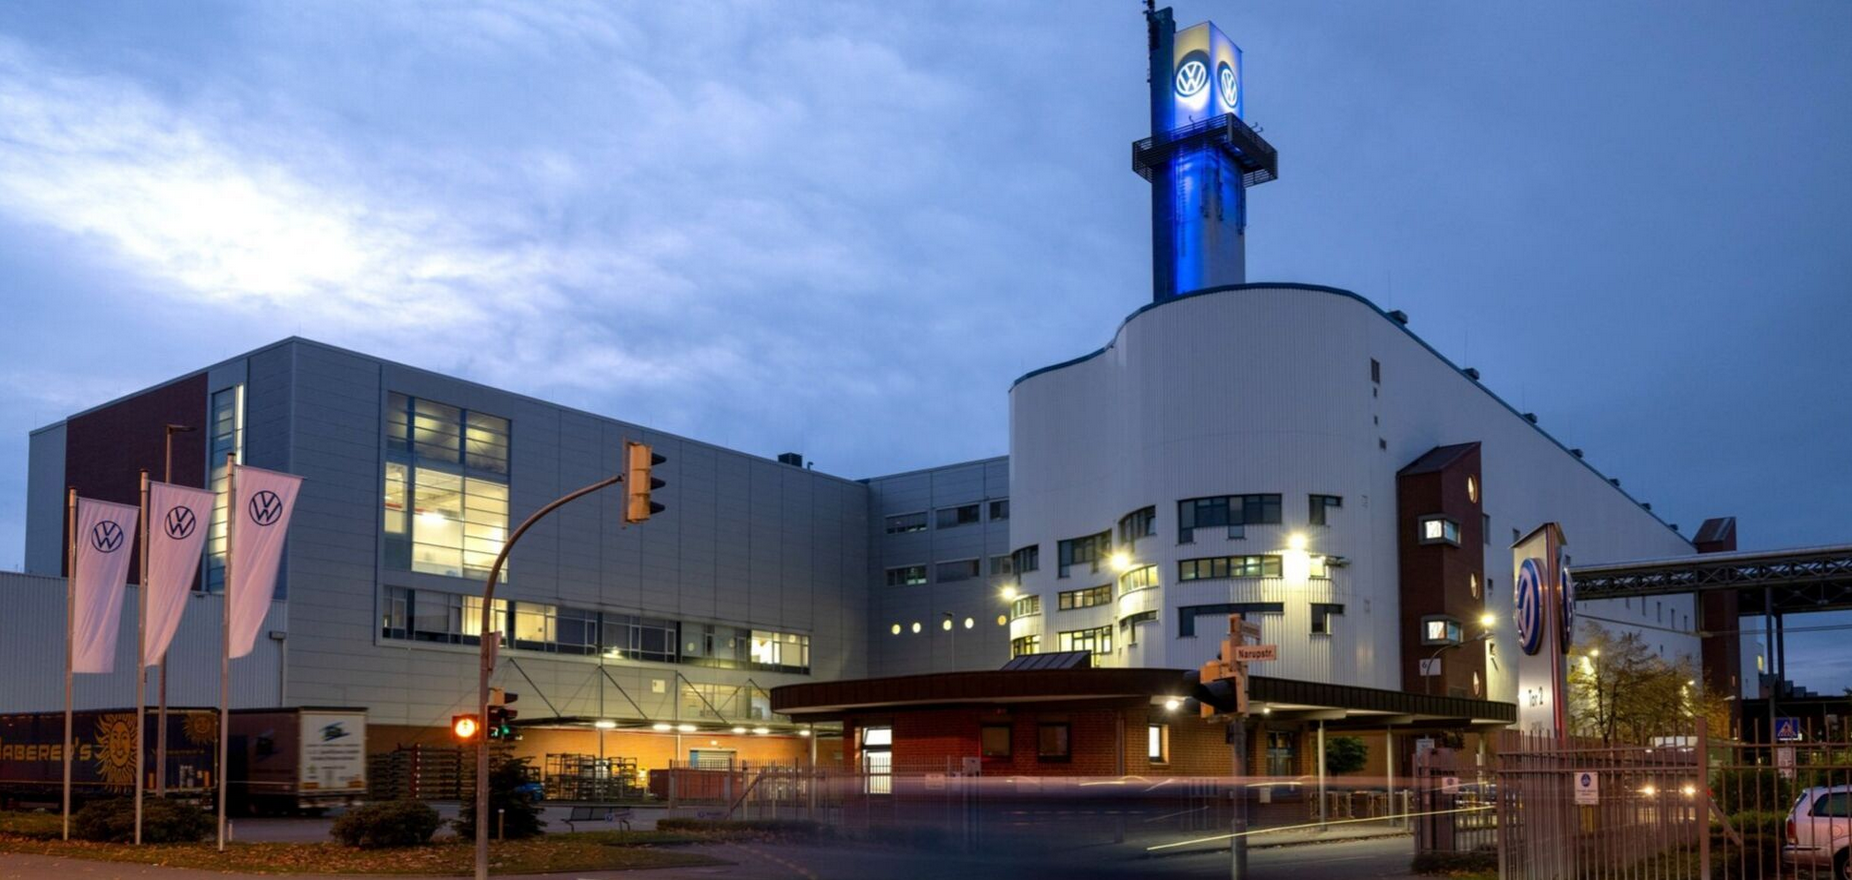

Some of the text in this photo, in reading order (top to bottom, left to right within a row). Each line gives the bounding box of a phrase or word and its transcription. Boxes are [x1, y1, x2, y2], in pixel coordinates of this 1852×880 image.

[1176, 61, 1207, 96] VW
[164, 505, 196, 540] VW
[249, 490, 283, 526] VW
[91, 520, 124, 553] VW
[1238, 649, 1274, 659] Narupstr.
[1528, 686, 1544, 708] Tor 2
[0, 736, 92, 761] ABERE'S
